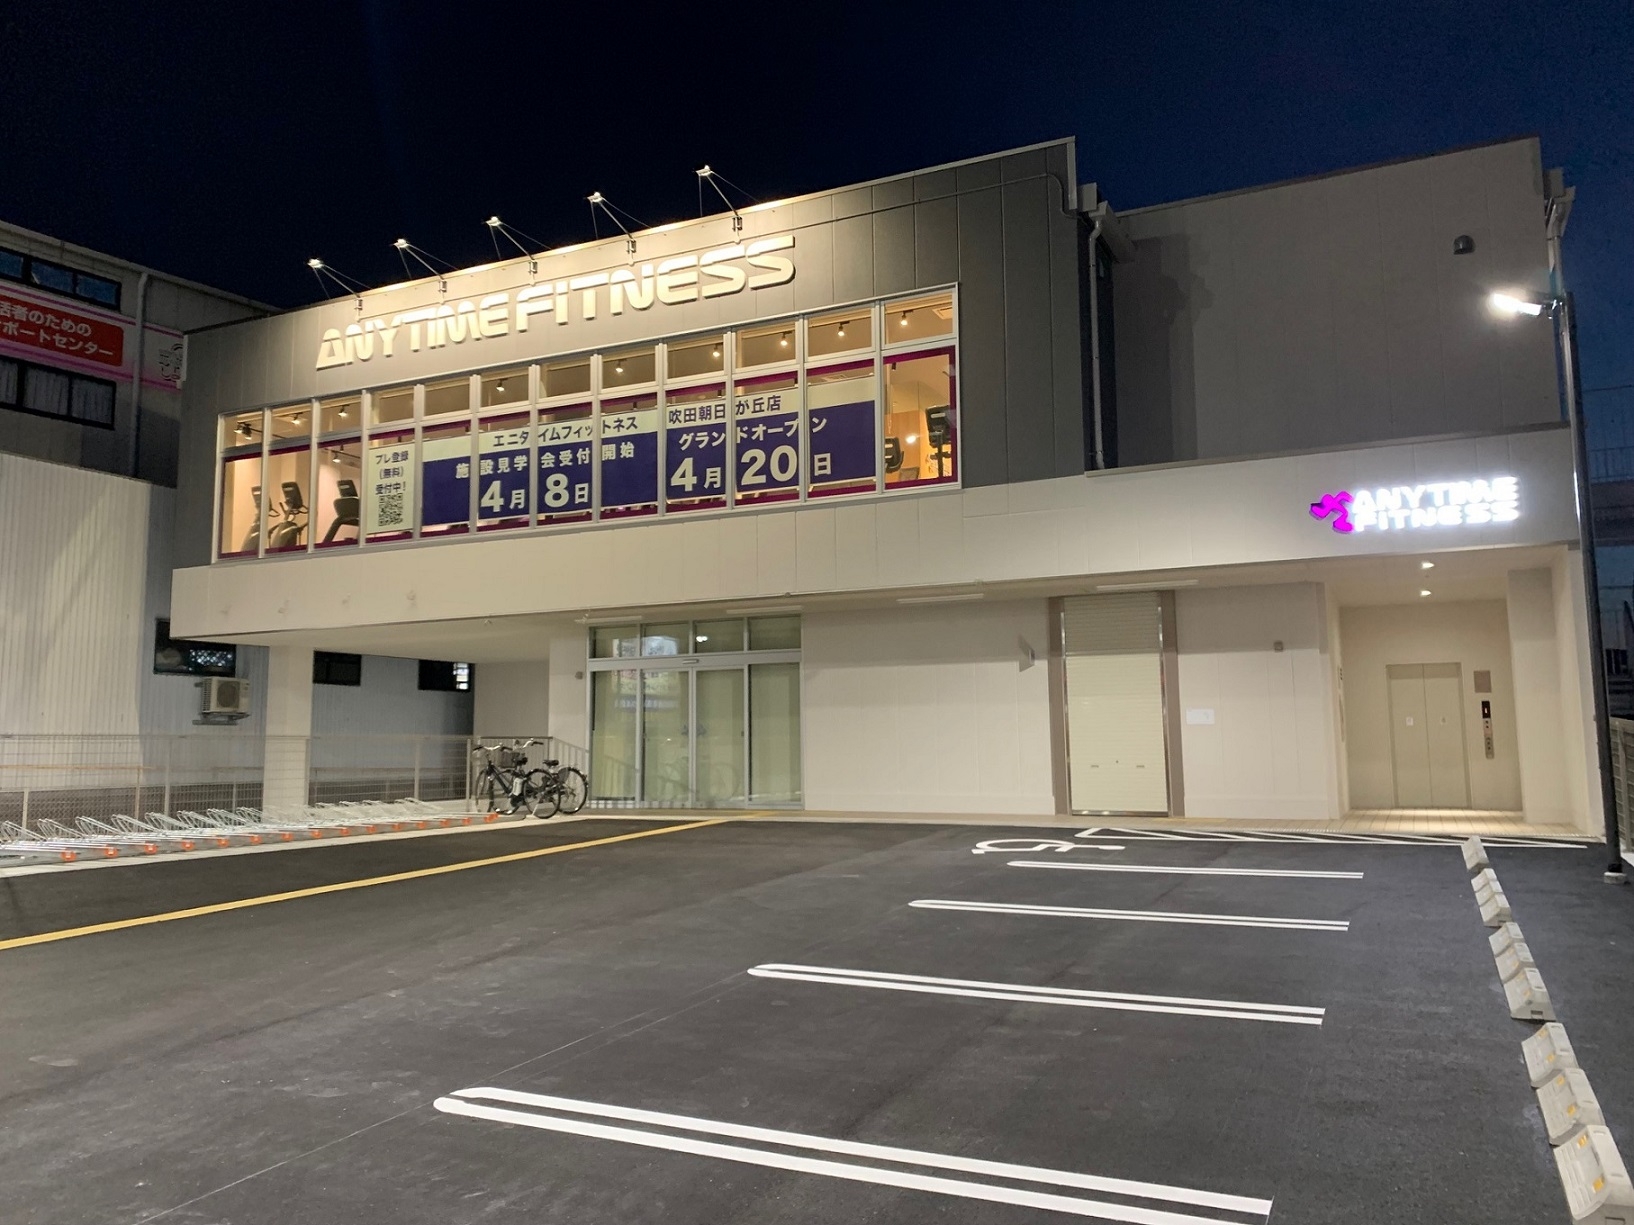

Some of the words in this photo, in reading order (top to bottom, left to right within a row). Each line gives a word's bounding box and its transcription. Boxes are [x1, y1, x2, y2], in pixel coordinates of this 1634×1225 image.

[315, 292, 510, 370] ANYTIME
[516, 235, 796, 332] FITNESS
[0, 321, 114, 356] ポートセンター
[669, 394, 782, 424] 吹田朝日が丘店
[1352, 476, 1518, 514] ANYTIME
[1354, 501, 1519, 532] FITNESS
